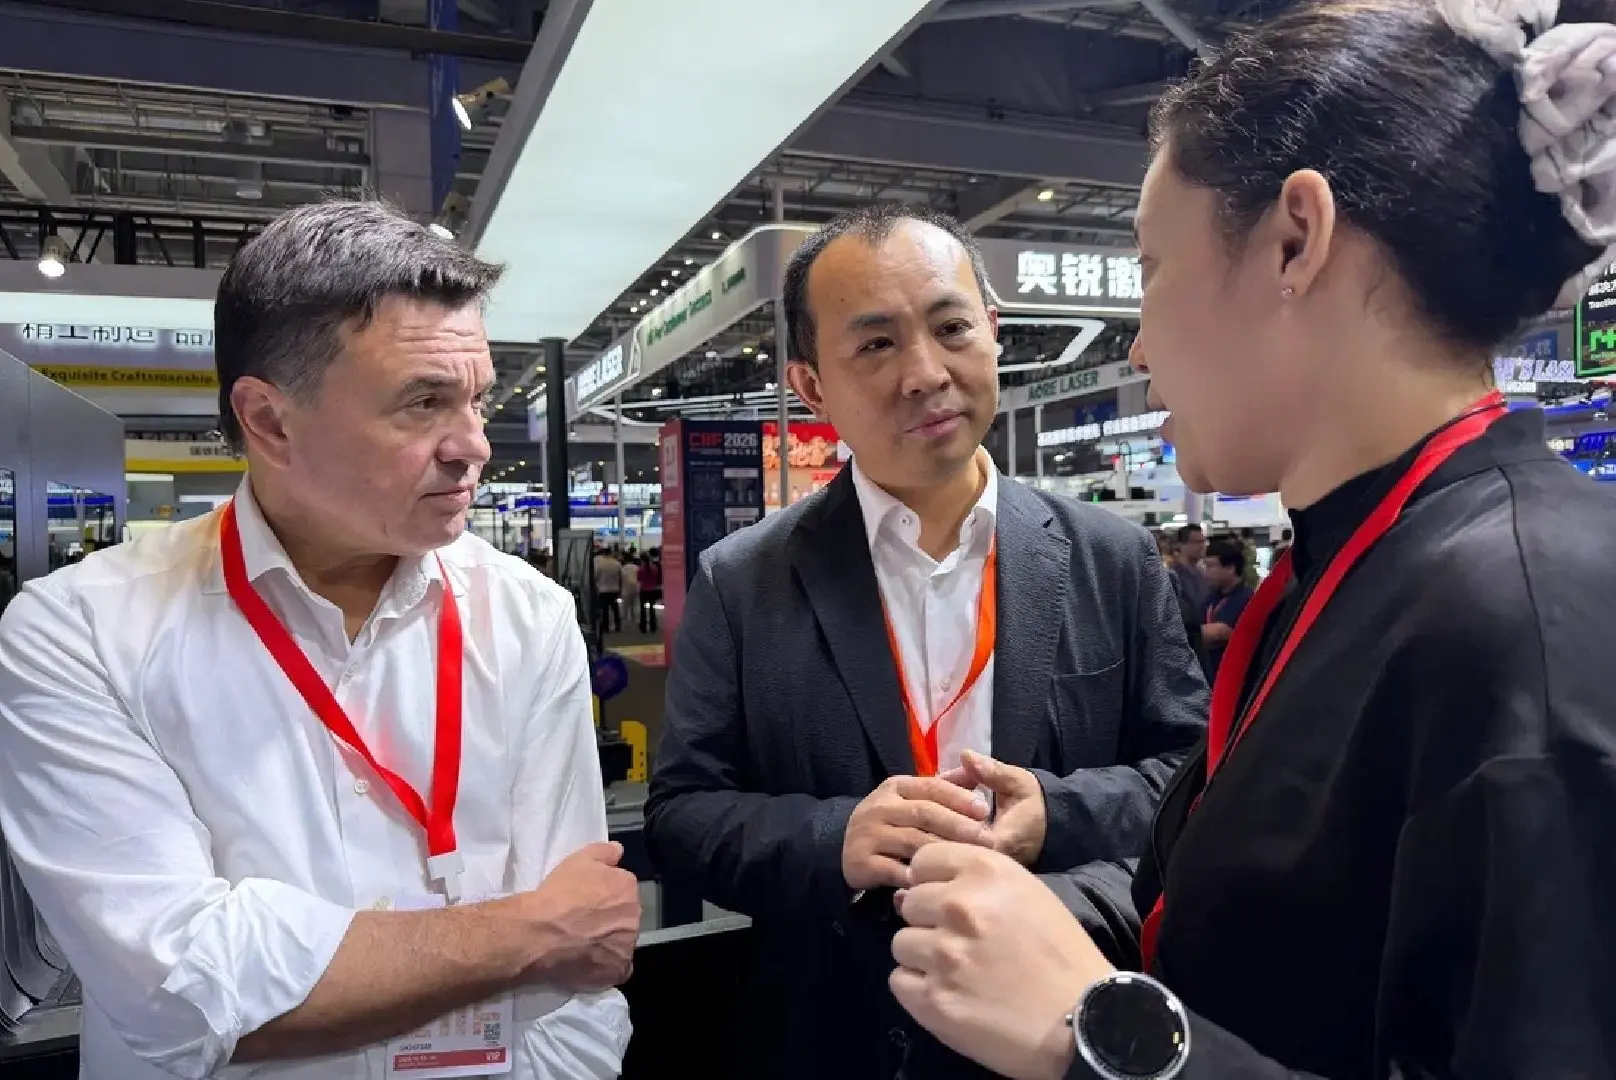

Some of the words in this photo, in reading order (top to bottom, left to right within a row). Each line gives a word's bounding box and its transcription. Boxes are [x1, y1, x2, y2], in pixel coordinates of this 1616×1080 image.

[42, 367, 108, 382] Exquisite
[1061, 370, 1098, 392] LASER
[724, 432, 758, 447] 2026
